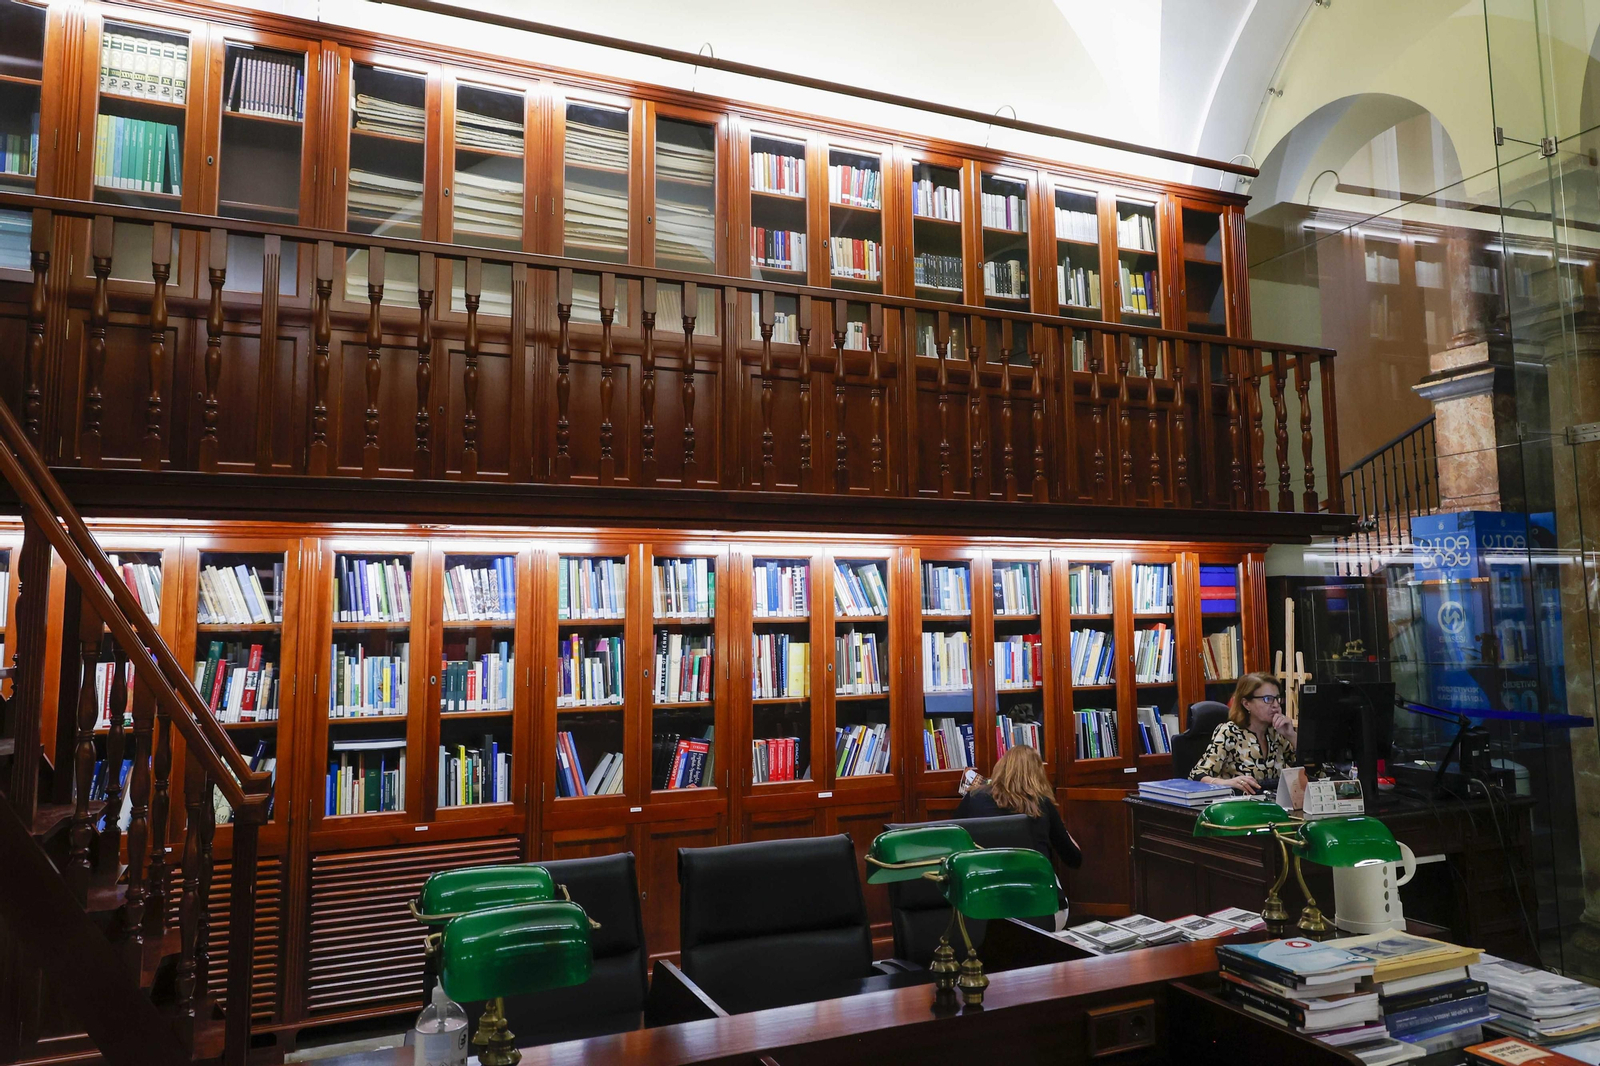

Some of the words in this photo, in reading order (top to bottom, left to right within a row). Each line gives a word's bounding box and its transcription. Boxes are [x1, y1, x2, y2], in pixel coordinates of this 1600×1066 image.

[1420, 535, 1470, 553] VIDA
[1421, 551, 1471, 569] AGUA
[1503, 680, 1537, 689] OBJETIVO
